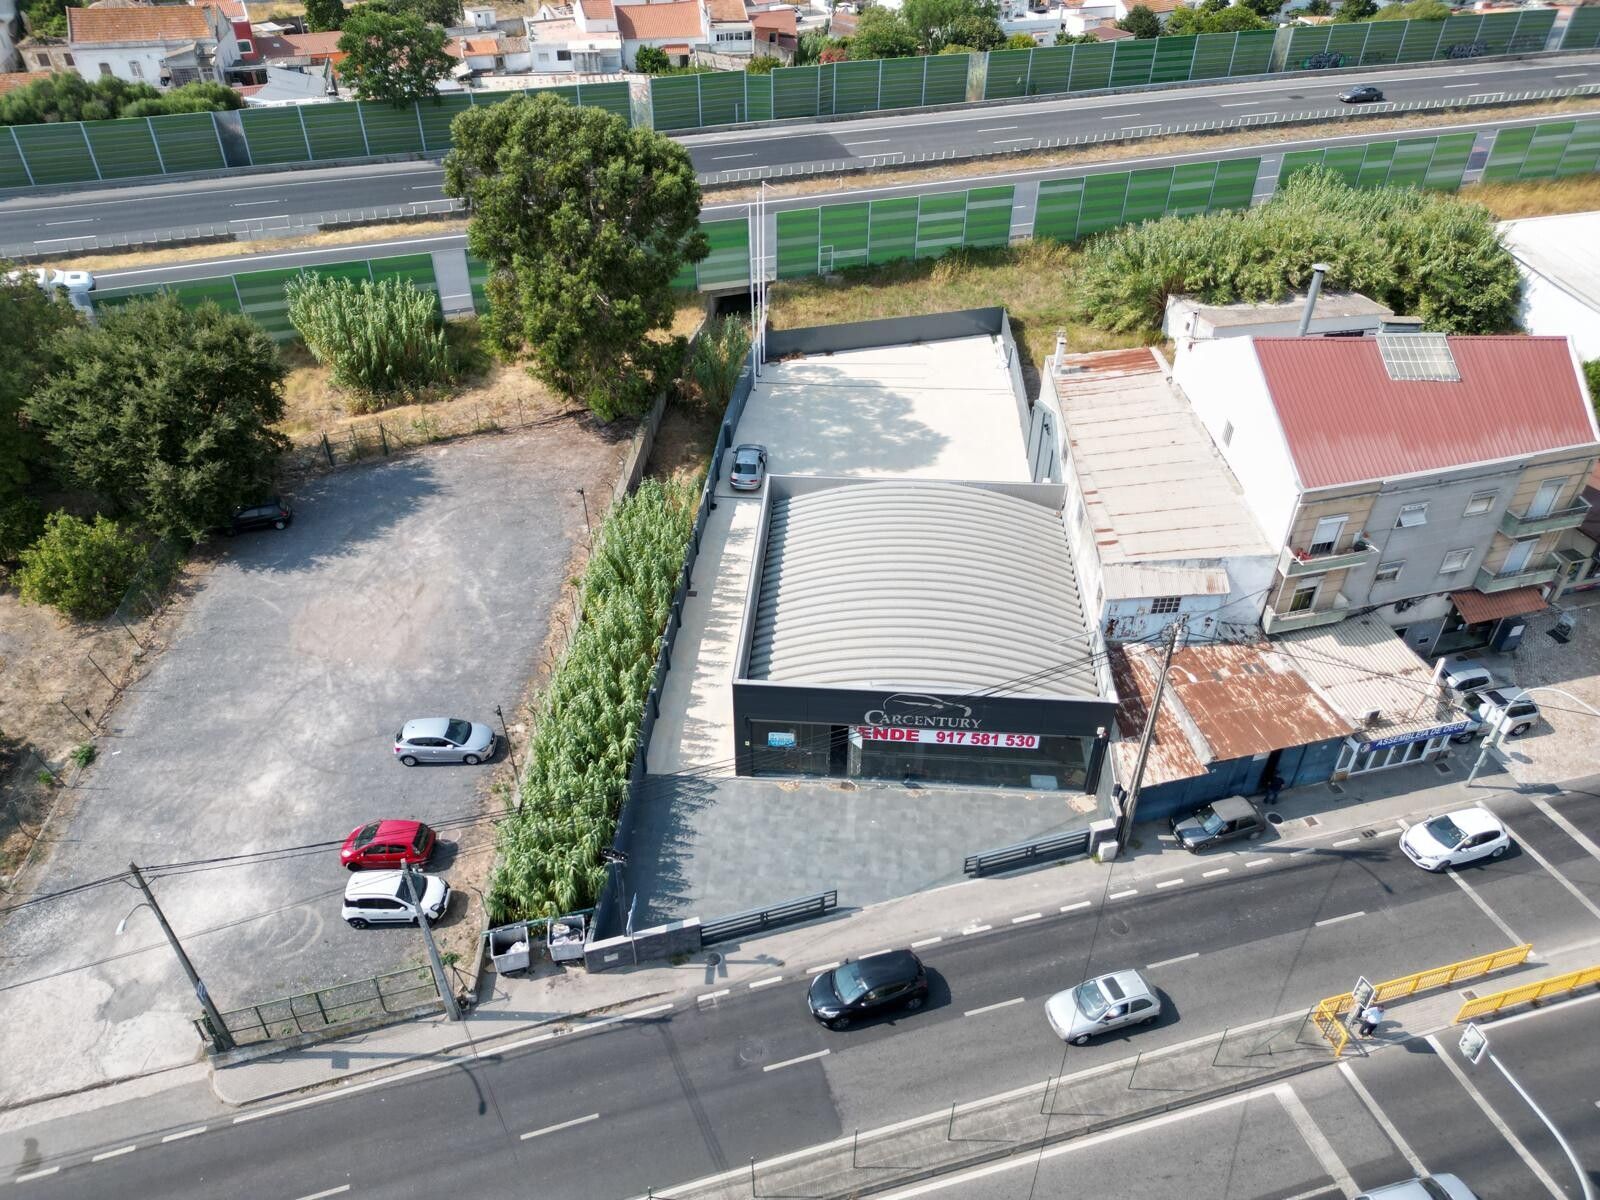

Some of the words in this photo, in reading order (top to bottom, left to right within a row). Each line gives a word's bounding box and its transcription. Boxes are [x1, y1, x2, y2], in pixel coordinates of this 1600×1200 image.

[864, 709, 982, 729] CARCENTURY
[936, 731, 966, 744] 917
[970, 733, 999, 746] 581
[1005, 734, 1036, 748] 530
[1376, 731, 1429, 746] ASSEMBLEIA
[1430, 728, 1441, 736] DE
[1443, 722, 1465, 733] DEUS
